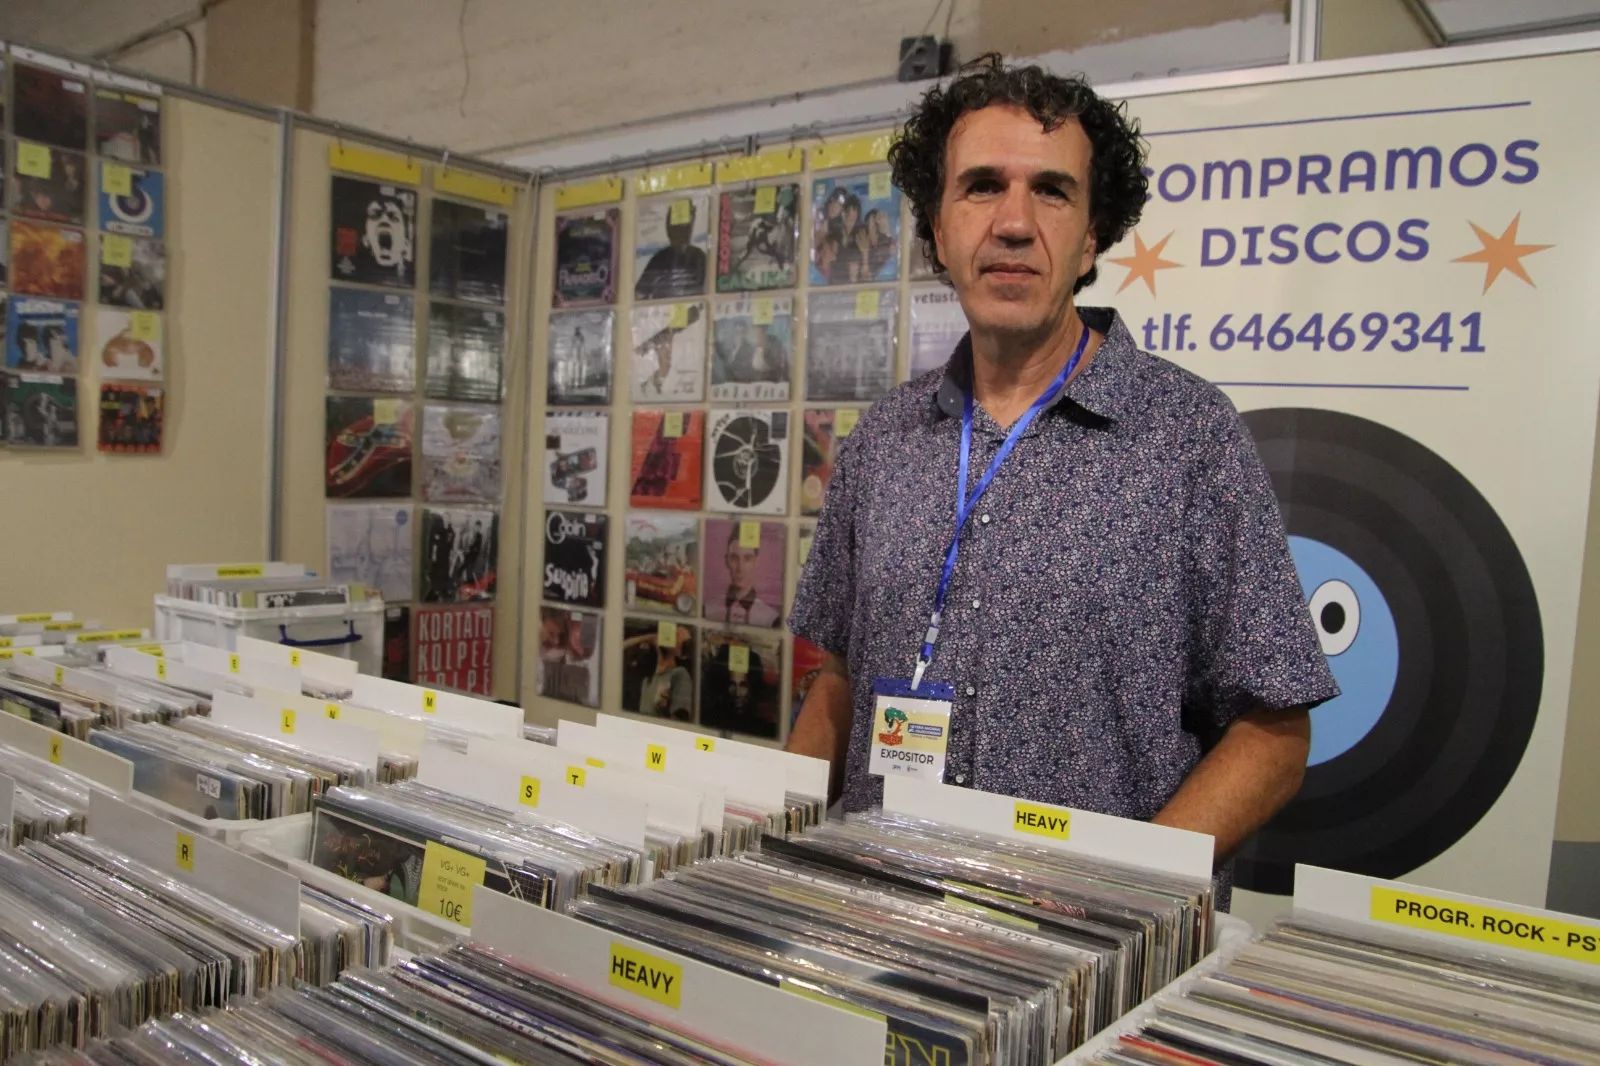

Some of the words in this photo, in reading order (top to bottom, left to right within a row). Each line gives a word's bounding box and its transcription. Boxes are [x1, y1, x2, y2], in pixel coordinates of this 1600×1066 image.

[1200, 218, 1430, 267] DISCOS
[913, 291, 959, 304] vetust
[1142, 313, 1197, 352] tlf.
[1209, 311, 1486, 353] 646469341
[417, 639, 491, 673] KOLPEZ
[426, 696, 434, 708] M
[284, 716, 291, 728] L
[329, 710, 336, 720] N
[52, 744, 58, 758] K
[651, 752, 662, 764] W
[880, 748, 934, 765] EXPOSITOR
[571, 774, 579, 786] T
[525, 785, 533, 799] S
[1016, 810, 1068, 833] HEAVY
[181, 843, 189, 862] R
[440, 859, 454, 872] VG+
[455, 864, 470, 878] VG+
[439, 897, 463, 923] 10€
[1395, 898, 1475, 929] PROGR.
[1482, 915, 1545, 942] ROCK
[1567, 931, 1600, 952] PS
[612, 954, 674, 995] HEAVY
